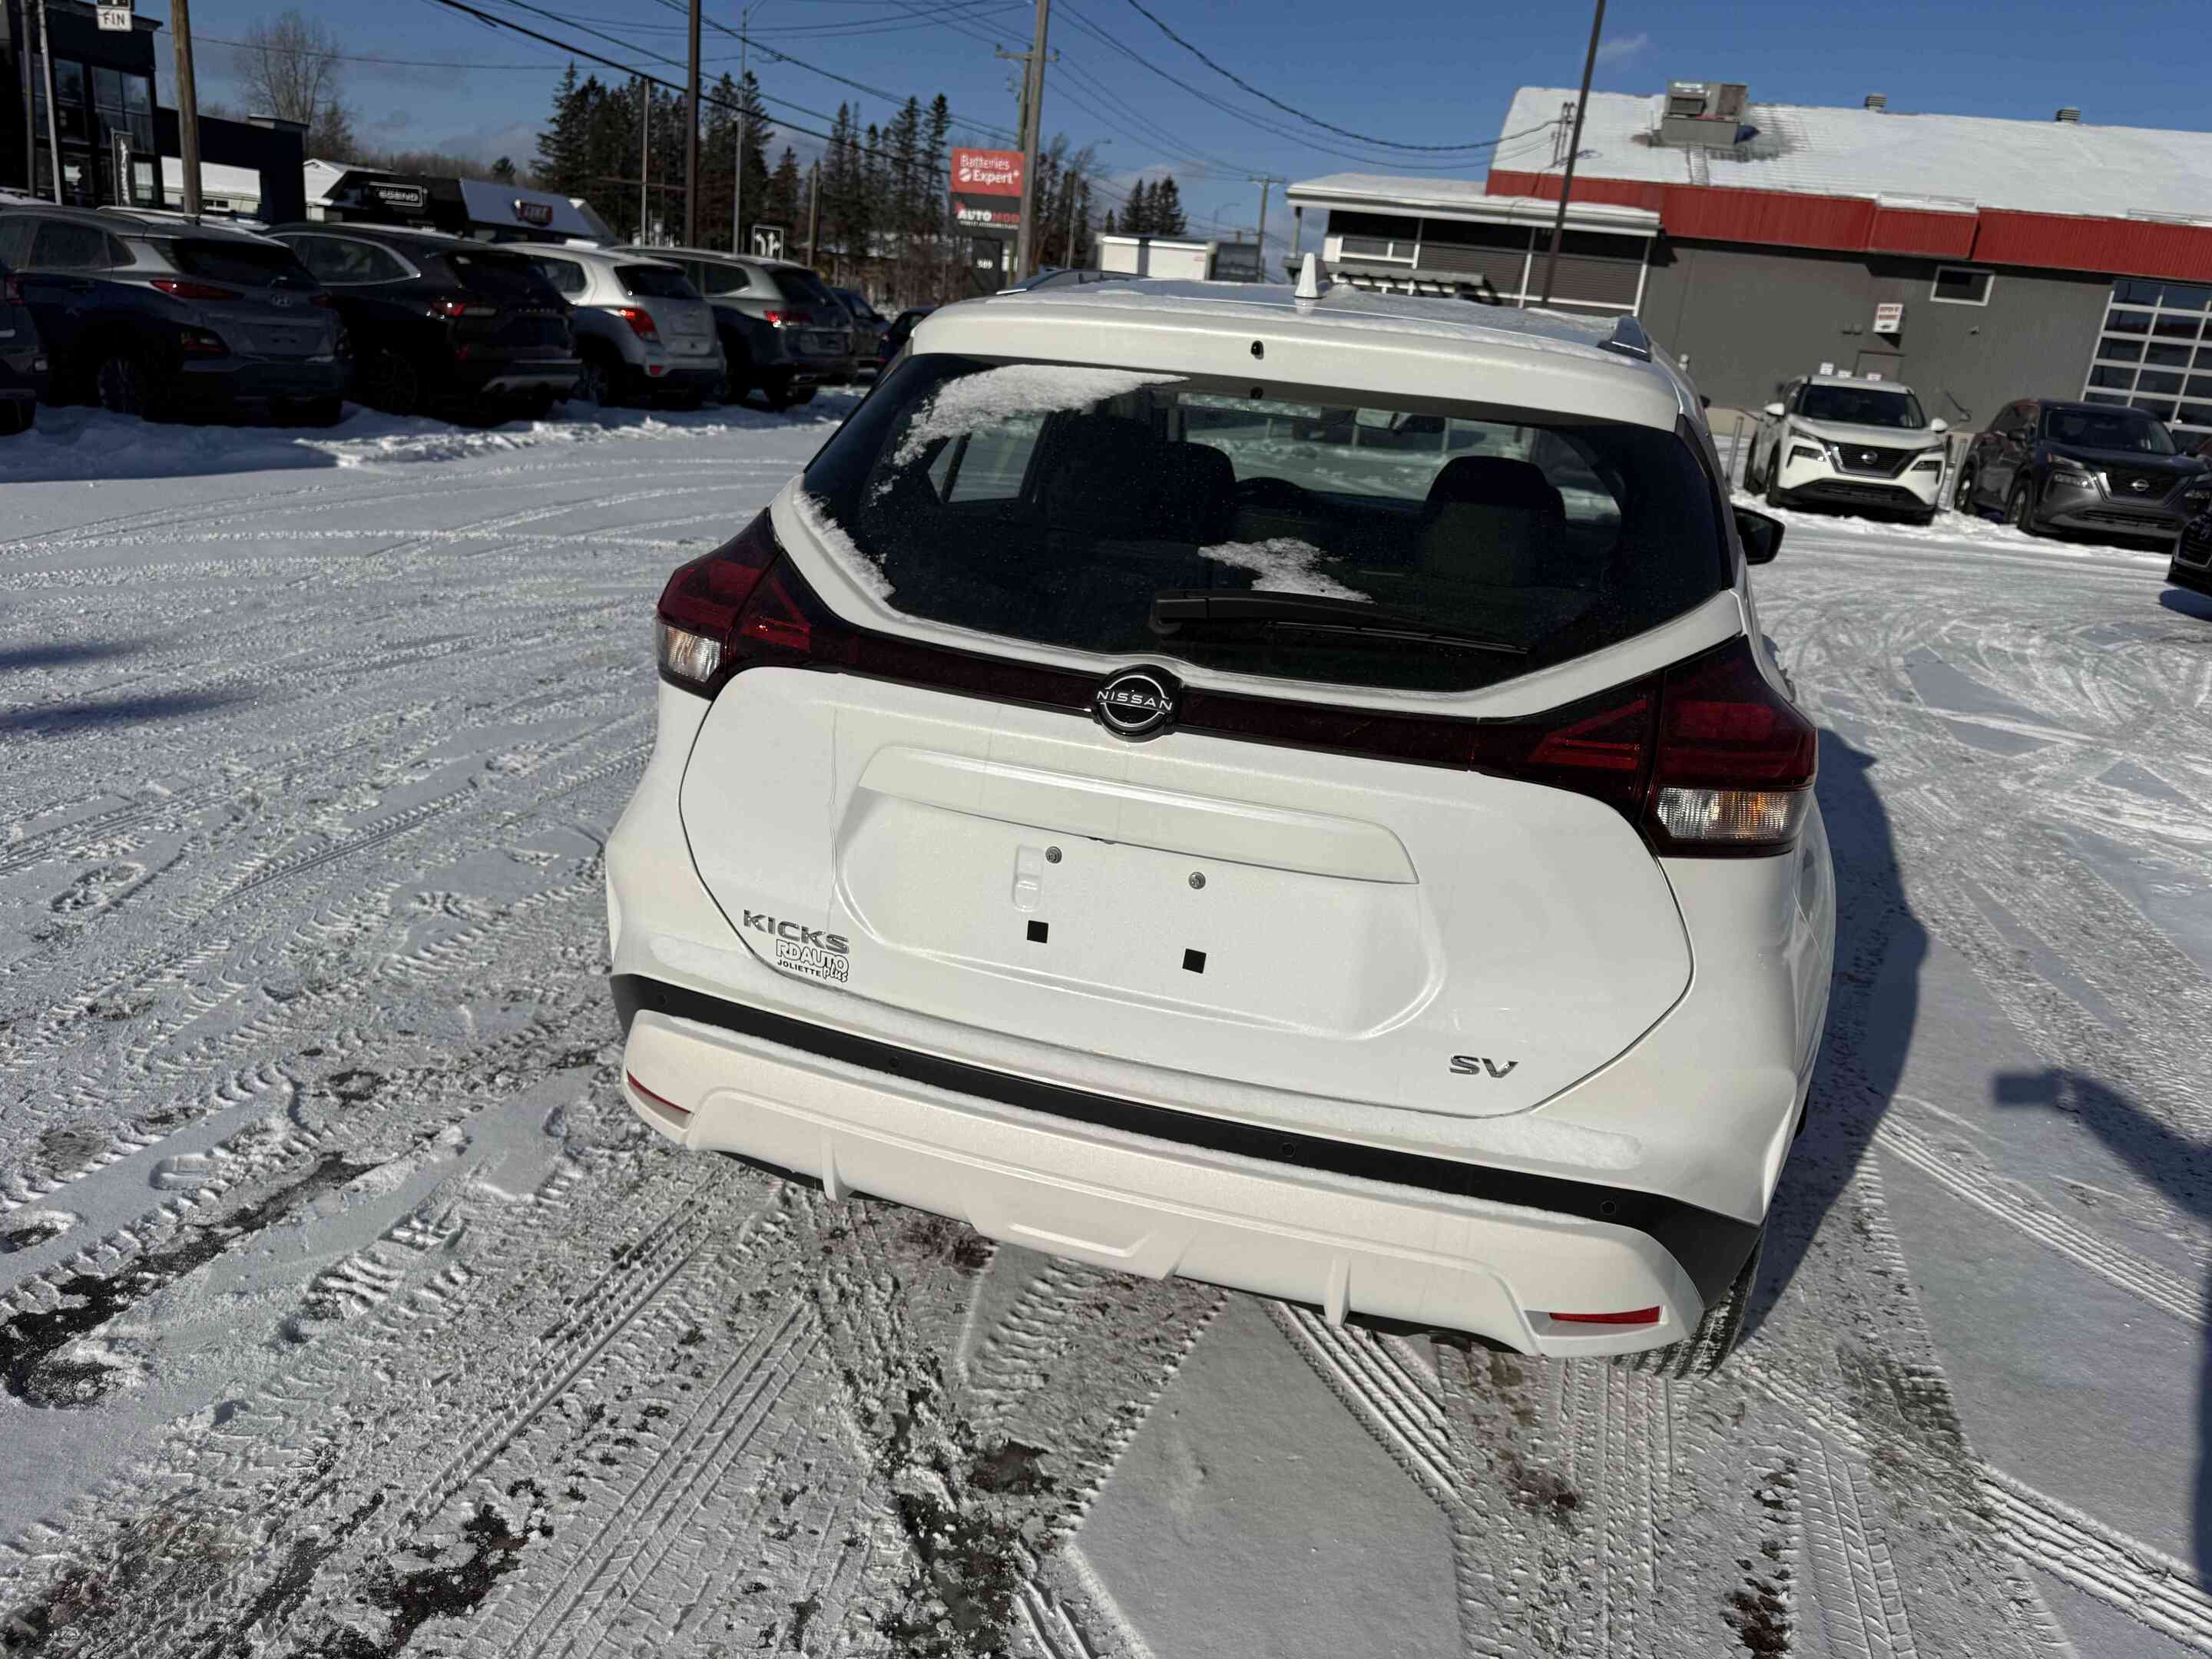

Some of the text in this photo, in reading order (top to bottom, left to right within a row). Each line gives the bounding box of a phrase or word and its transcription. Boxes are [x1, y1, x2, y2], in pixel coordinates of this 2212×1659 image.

[104, 12, 125, 25] FIN
[960, 154, 1011, 171] Batteries
[1097, 690, 1173, 711] NISSAN
[743, 909, 849, 955] KICKS
[777, 959, 849, 982] JOLIETTE plus
[1449, 1055, 1519, 1078] SV
